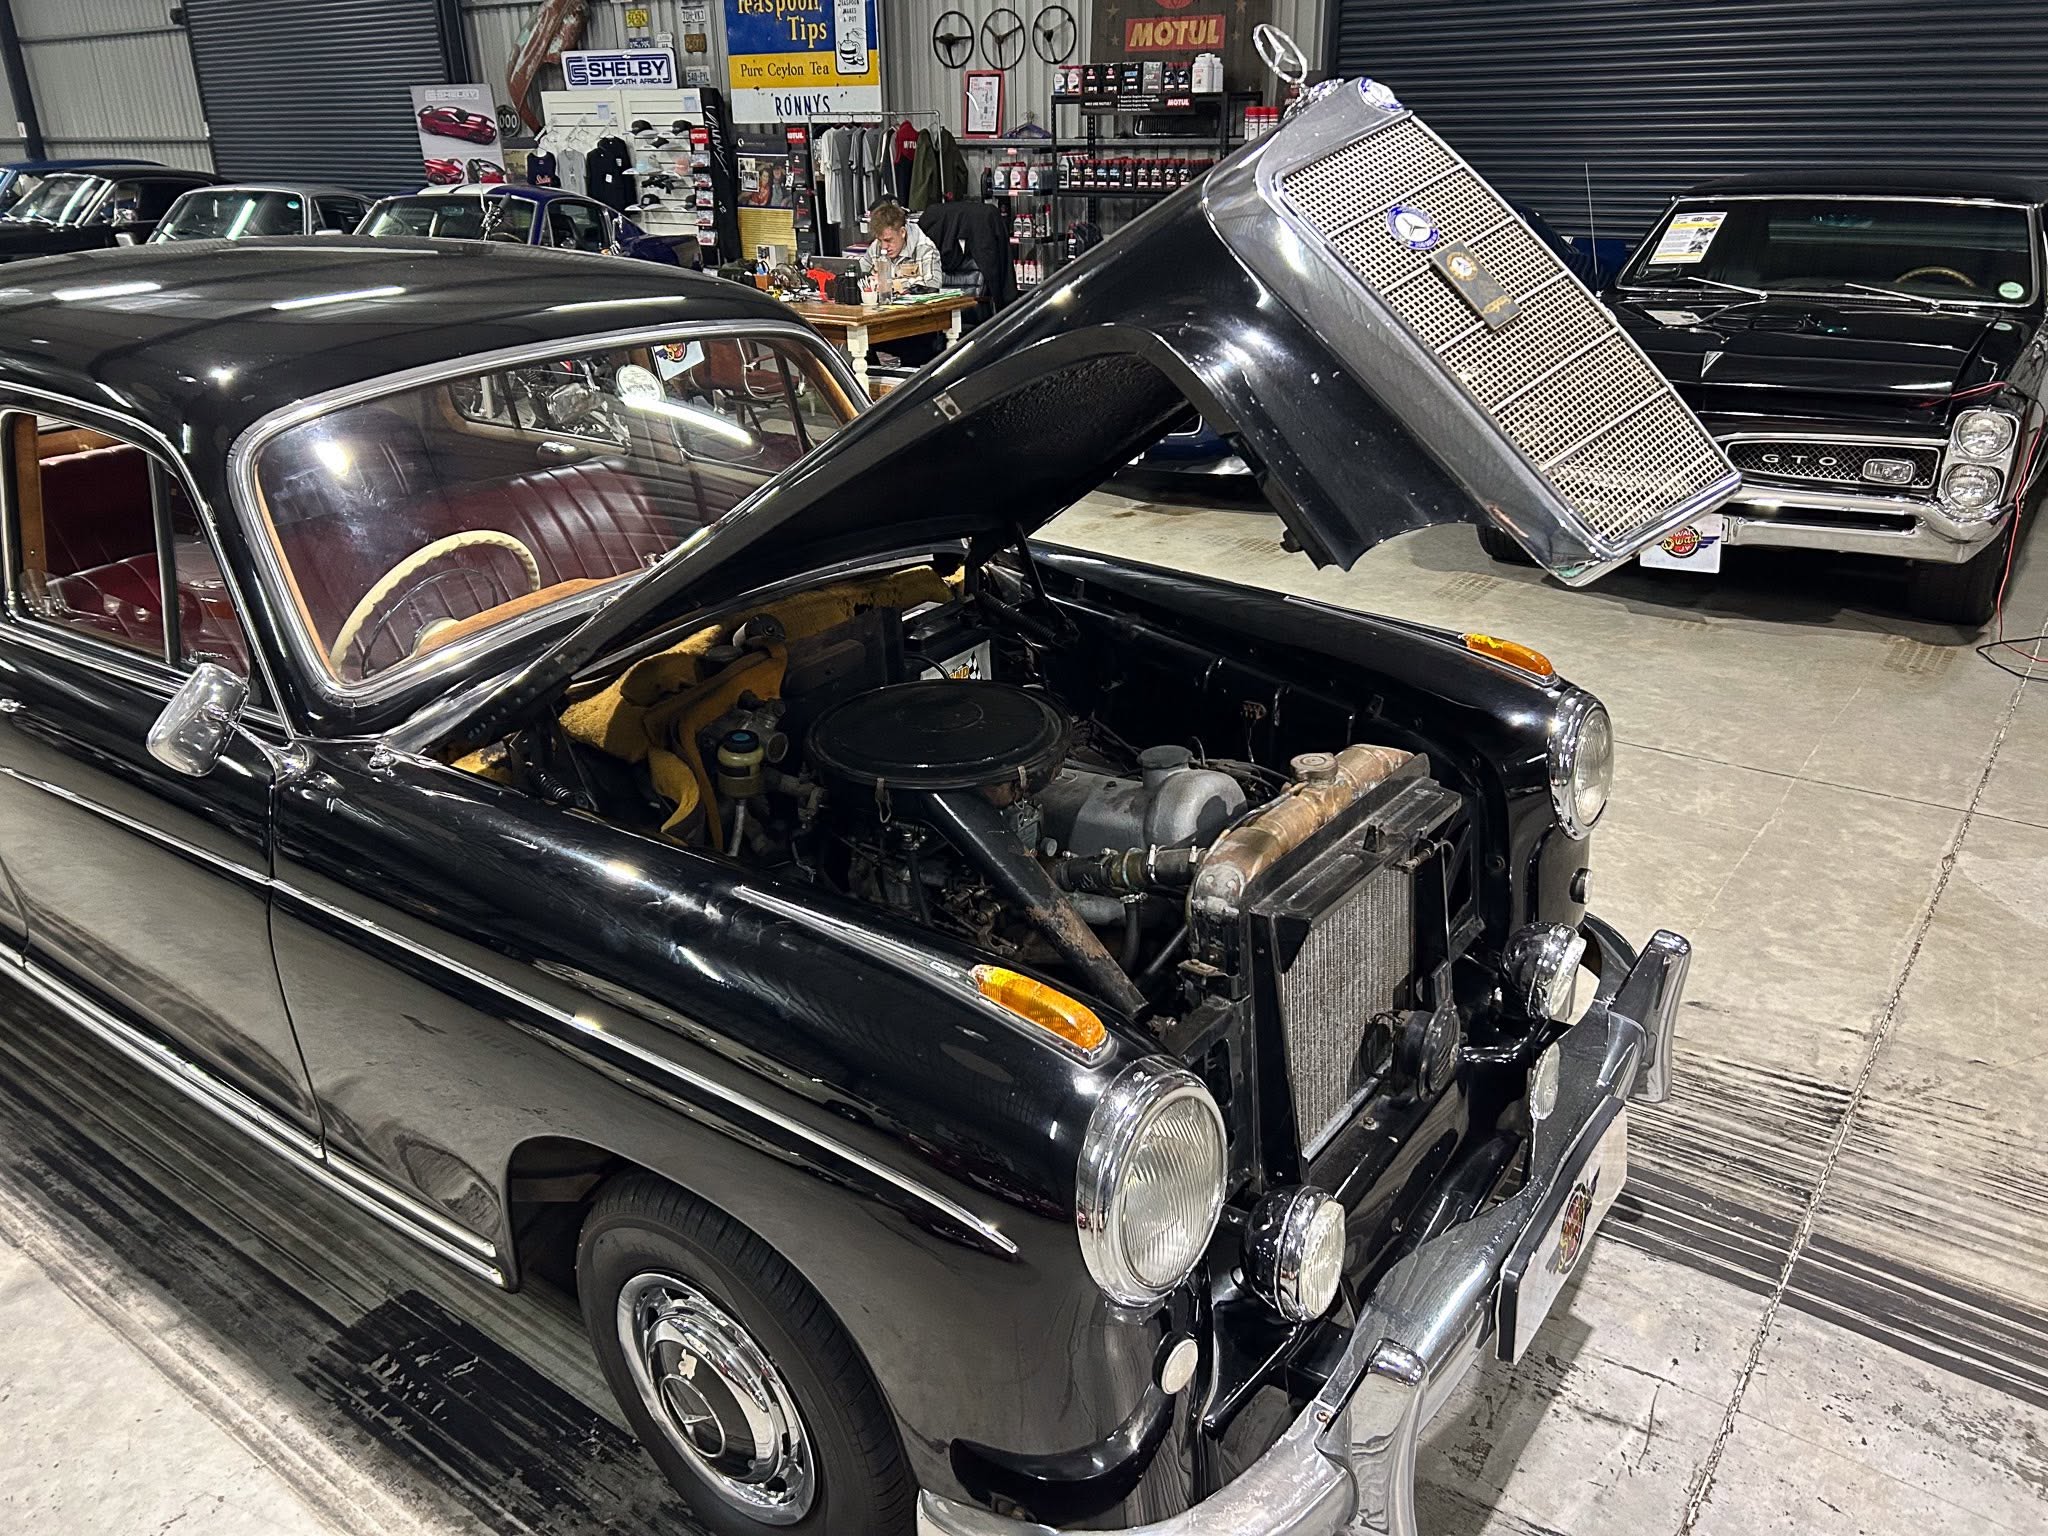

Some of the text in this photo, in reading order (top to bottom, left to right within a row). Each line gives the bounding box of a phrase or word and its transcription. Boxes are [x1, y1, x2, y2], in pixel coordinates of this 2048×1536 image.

[787, 14, 828, 49] Tips
[1129, 19, 1219, 47] MOTUL
[589, 60, 665, 78] SHELBY
[740, 61, 830, 79] Pure Ceylon Tea
[775, 95, 831, 116] RONNYS
[1166, 98, 1190, 107] MOTUL
[1761, 453, 1838, 466] GTO
